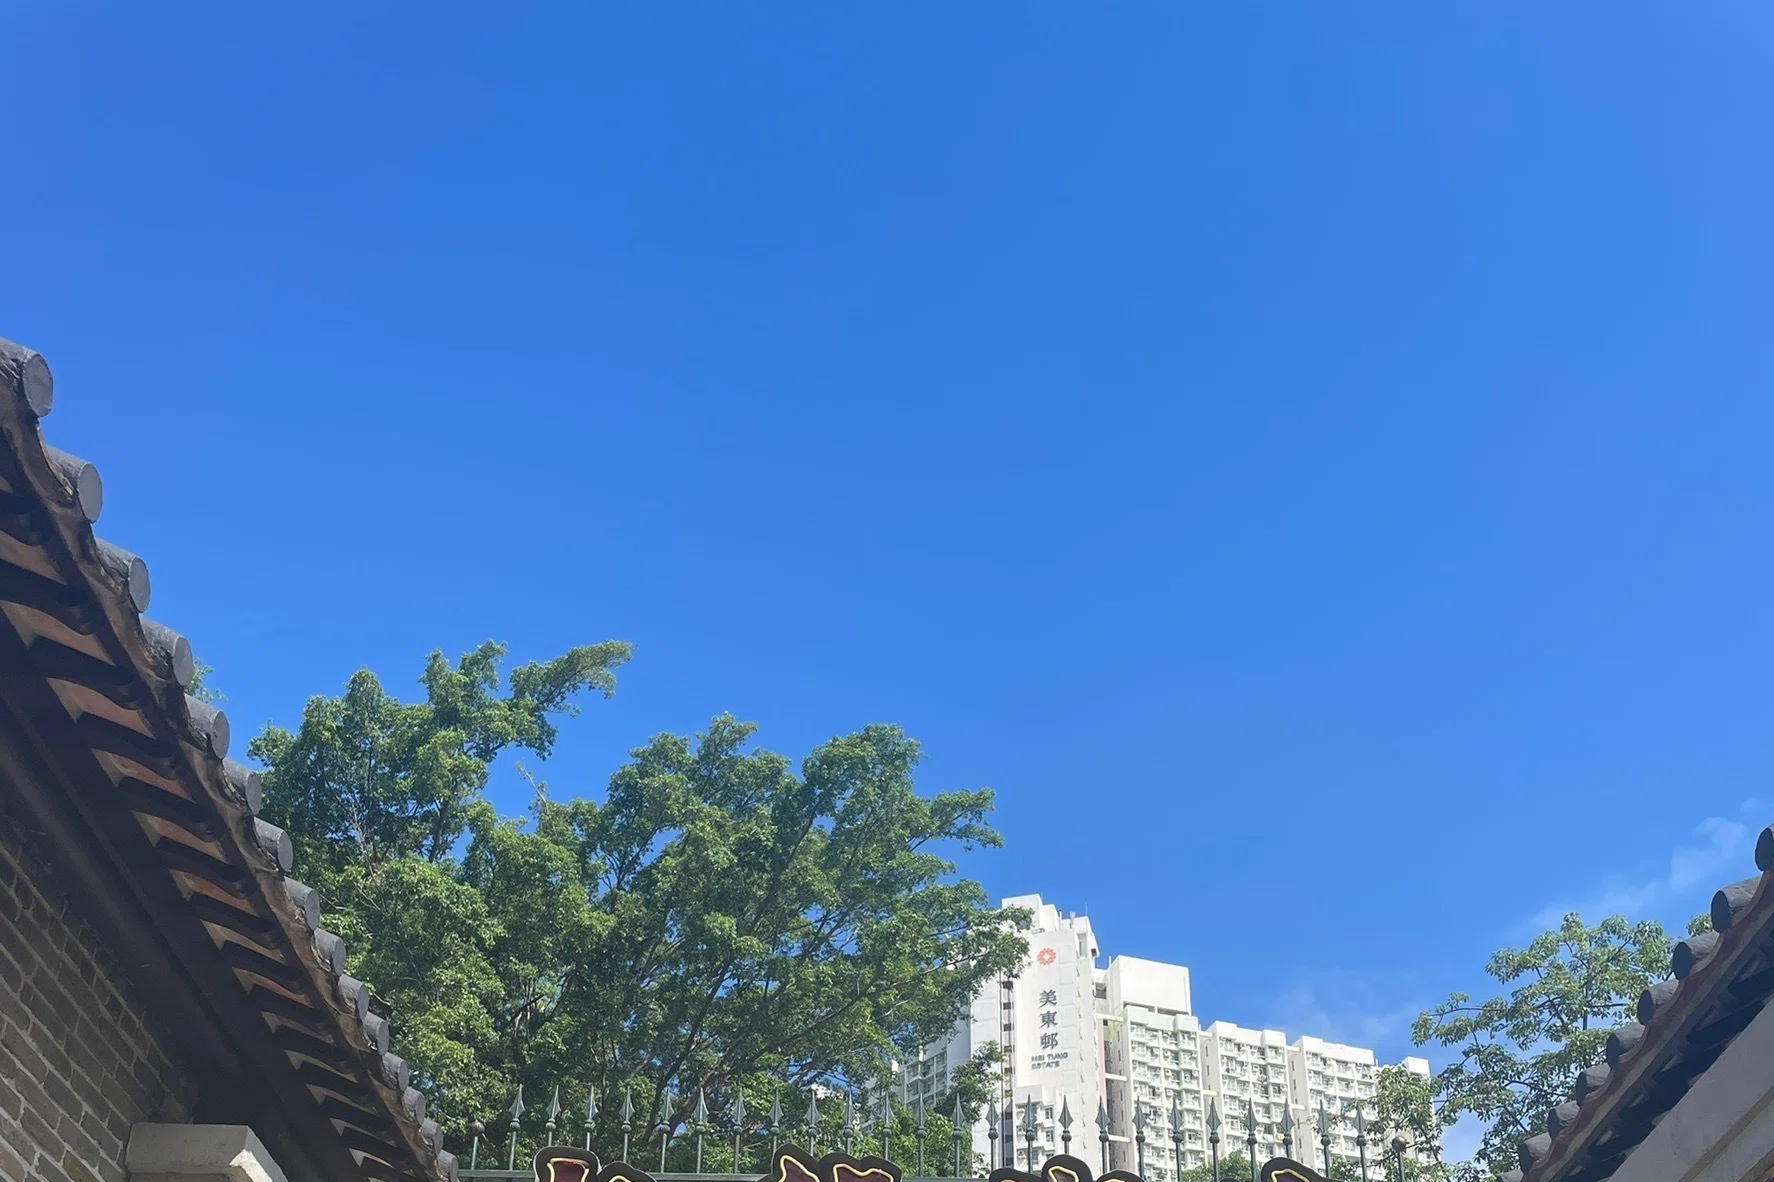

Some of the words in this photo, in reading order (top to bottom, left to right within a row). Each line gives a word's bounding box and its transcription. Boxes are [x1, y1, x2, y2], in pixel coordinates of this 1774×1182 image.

[1039, 989, 1058, 1050] 美東邨
[1047, 1052, 1068, 1061] TUNG
